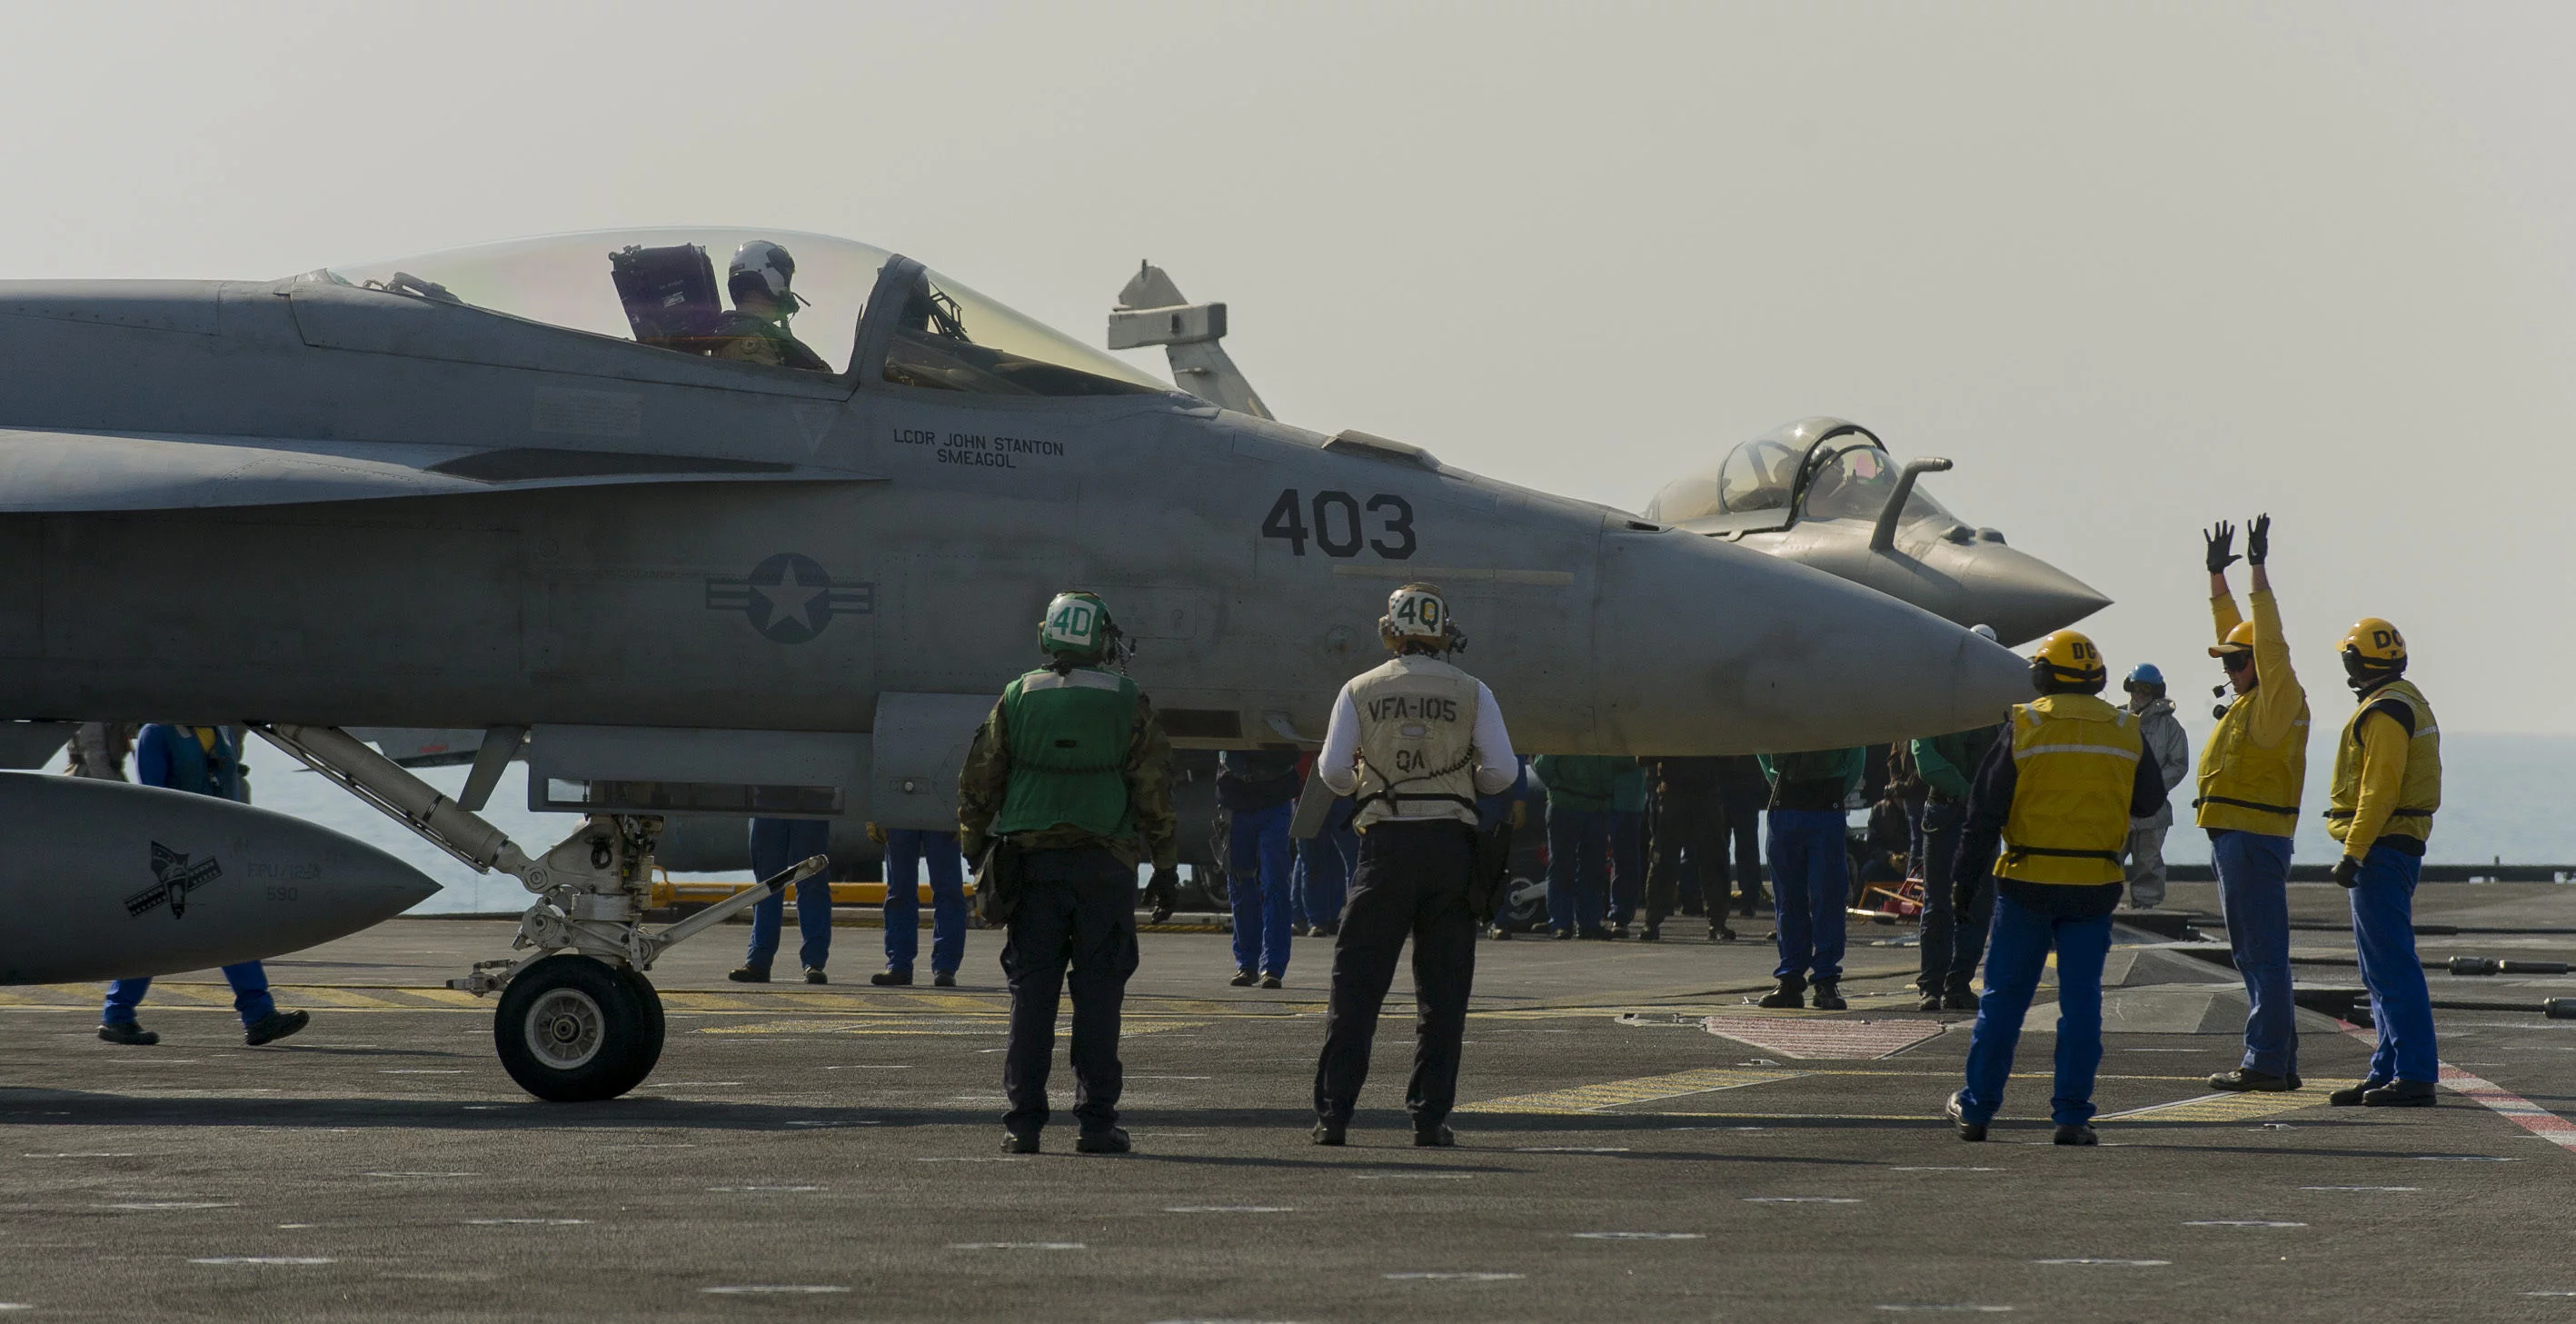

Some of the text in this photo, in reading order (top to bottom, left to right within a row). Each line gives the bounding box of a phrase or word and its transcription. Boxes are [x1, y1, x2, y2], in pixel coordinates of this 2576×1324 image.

[893, 428, 1064, 456] LCDR JOHN STANTON
[937, 449, 1017, 468] SMEAGOL
[1262, 488, 1417, 560] 403
[1052, 606, 1091, 636] 4D
[1397, 596, 1439, 632] 4Q
[2072, 642, 2097, 660] DC
[2372, 629, 2403, 650] DC
[1368, 696, 1457, 722] VFA-105
[1397, 749, 1425, 772] QA
[266, 887, 298, 902] 590
